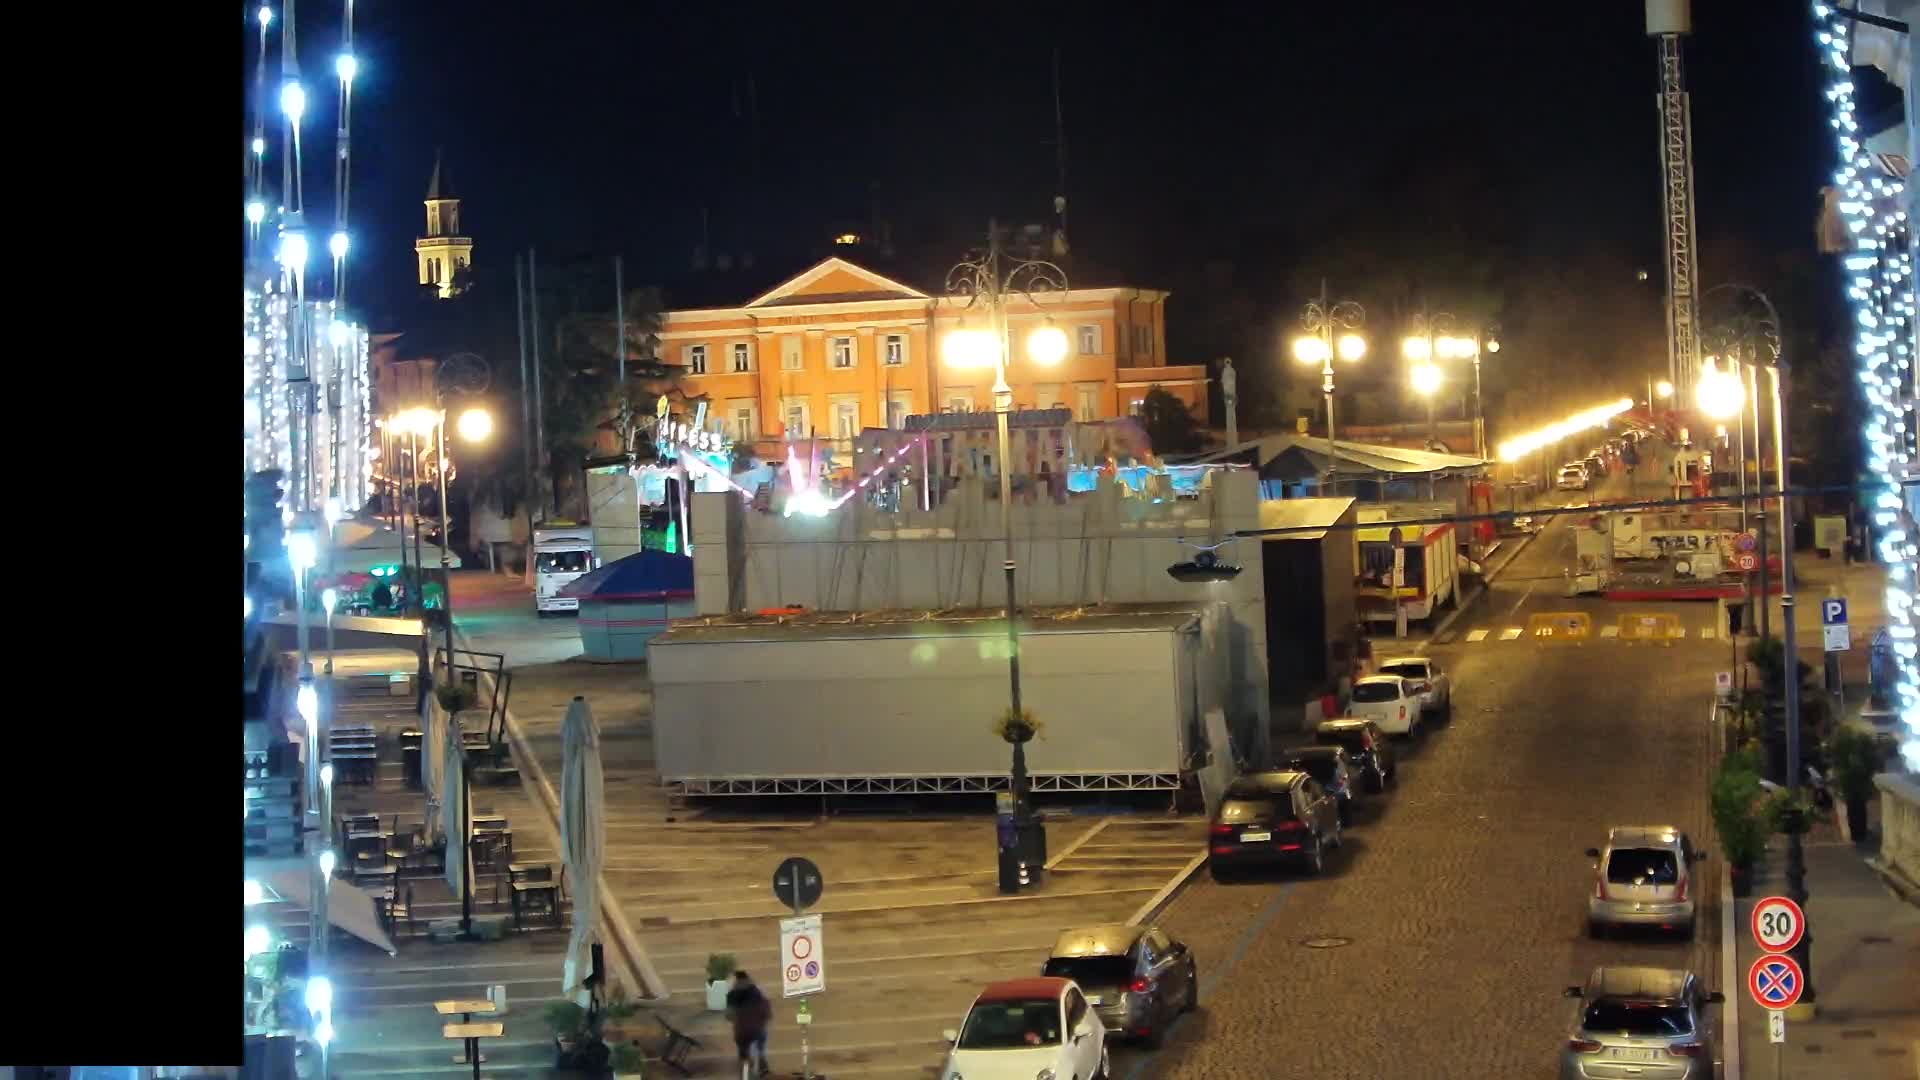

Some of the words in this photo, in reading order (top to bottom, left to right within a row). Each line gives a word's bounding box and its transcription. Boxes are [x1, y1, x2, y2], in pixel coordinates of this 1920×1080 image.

[1742, 558, 1752, 567] 20
[1827, 602, 1842, 622] P
[1762, 912, 1791, 937] 30
